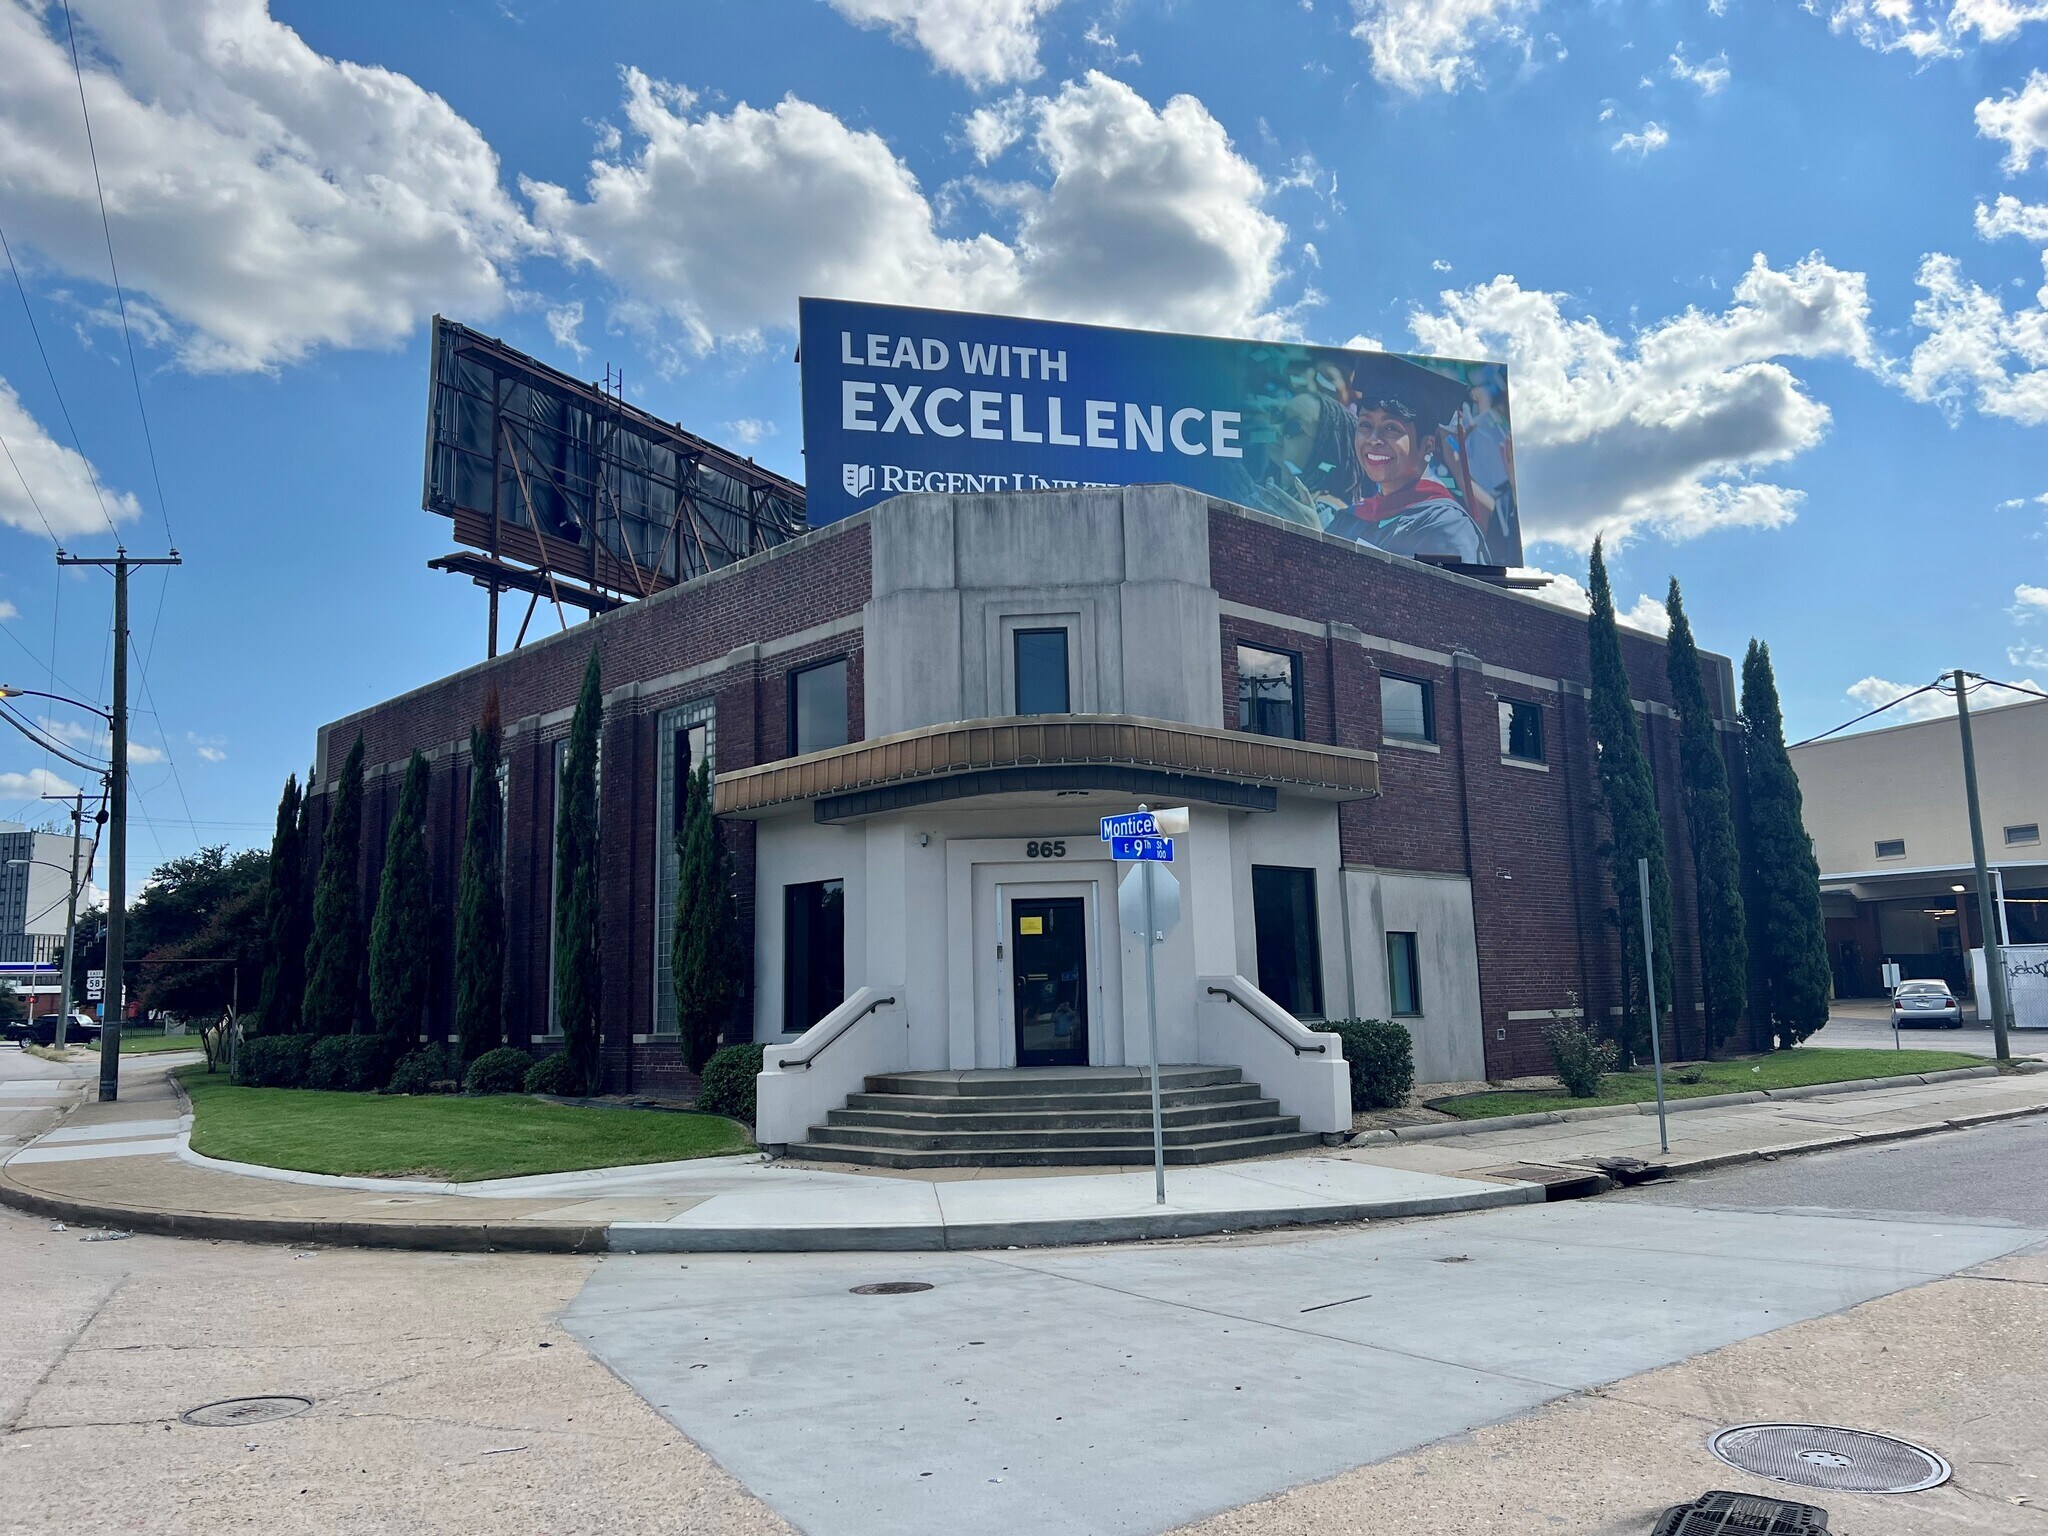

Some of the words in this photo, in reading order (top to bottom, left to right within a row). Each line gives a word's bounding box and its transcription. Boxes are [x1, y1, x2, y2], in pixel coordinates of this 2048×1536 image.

[841, 331, 950, 371] LEAD
[958, 341, 1068, 382] WITH
[842, 380, 1244, 459] EXCELLENCE
[880, 465, 1008, 494] REGENT
[1026, 840, 1066, 858] 865
[1124, 843, 1130, 853] E
[1156, 840, 1163, 850] St
[1156, 850, 1167, 859] 100
[89, 979, 100, 988] 58
